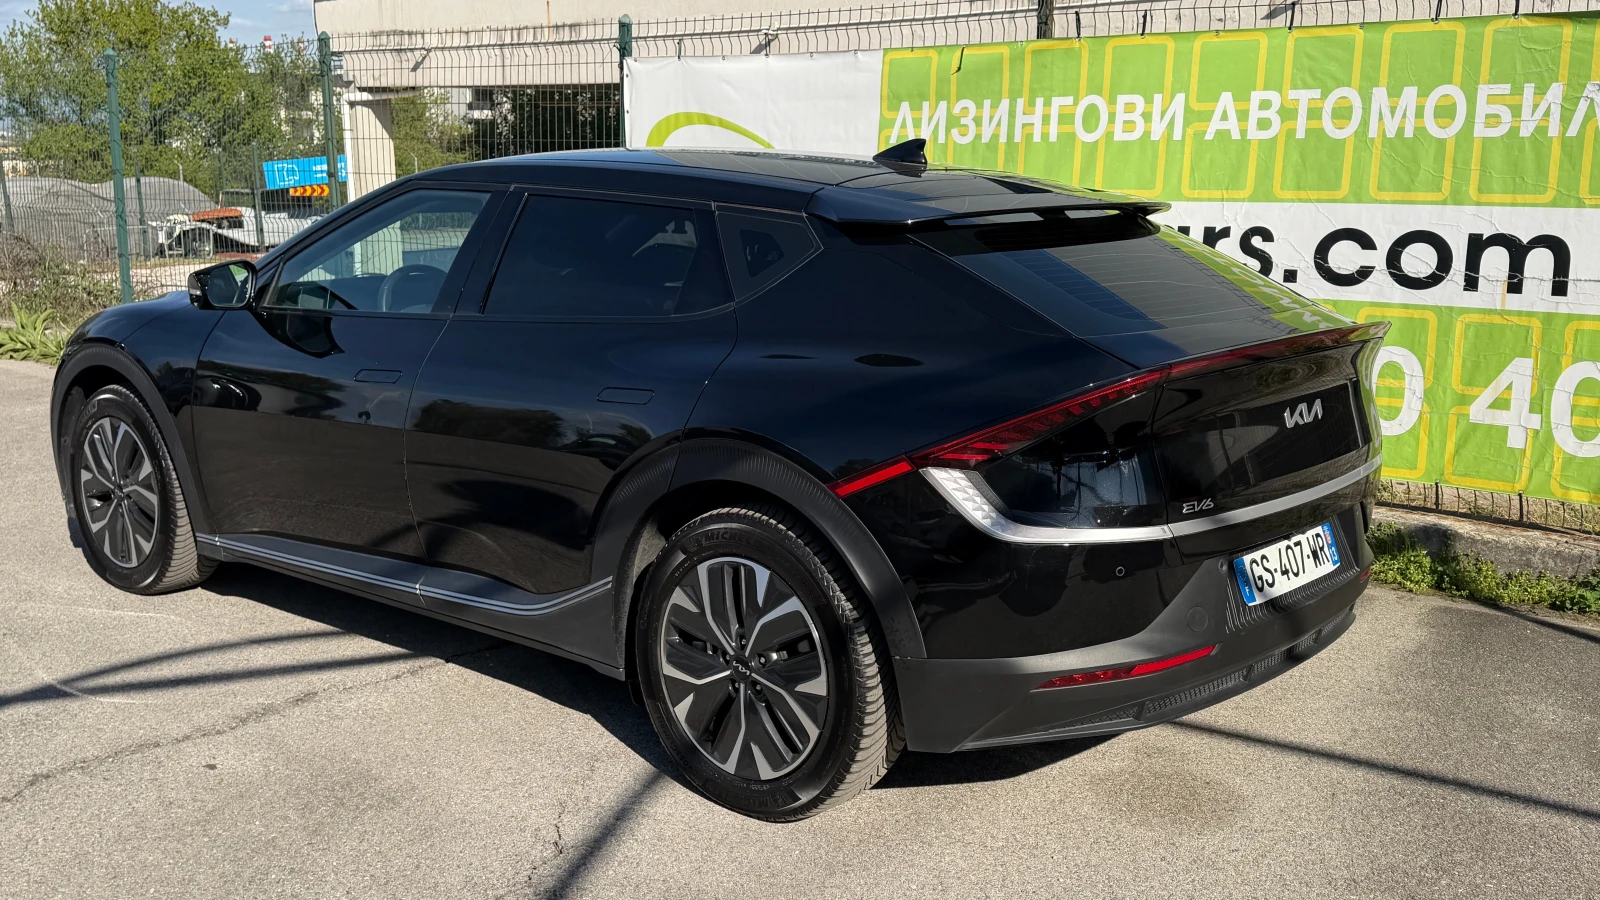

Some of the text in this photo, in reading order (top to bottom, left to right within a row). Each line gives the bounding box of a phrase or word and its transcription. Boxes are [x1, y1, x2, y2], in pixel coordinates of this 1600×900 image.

[889, 81, 1600, 145] ЛИЗИНГОВИ АВТОМОБИЛ
[1164, 225, 1571, 298] rs.com
[1284, 399, 1324, 429] KIA
[1182, 498, 1214, 514] EV6
